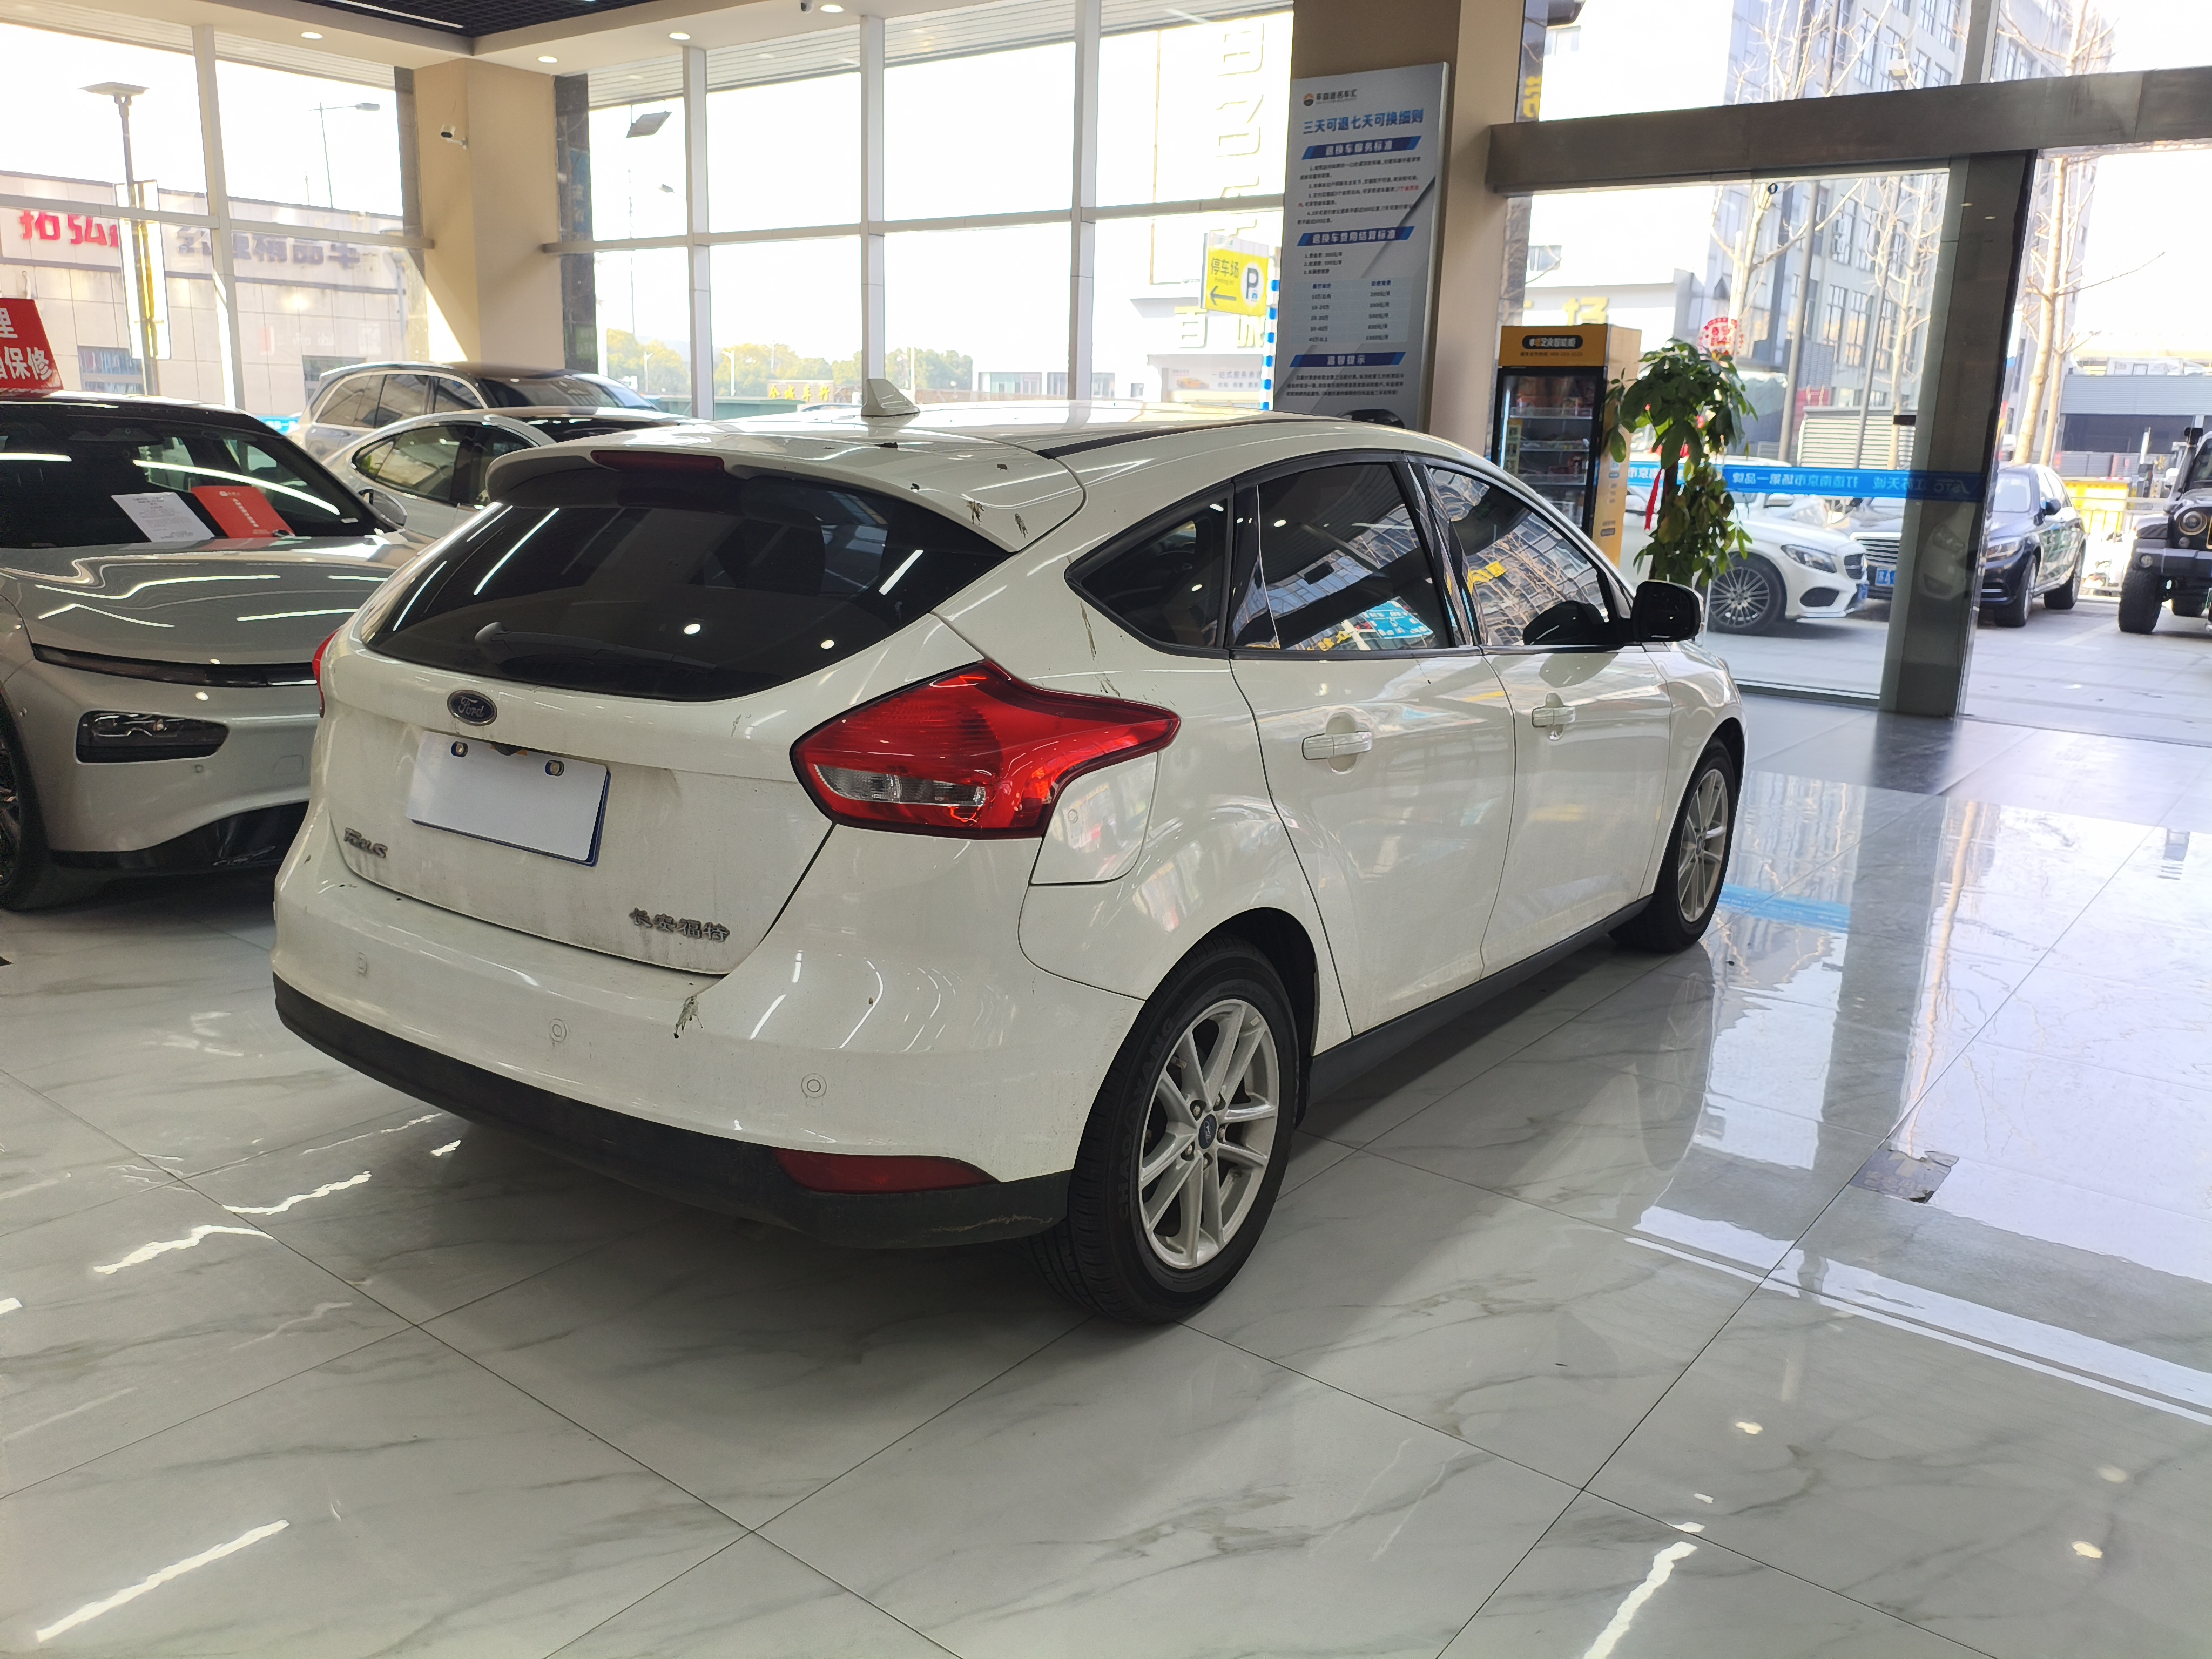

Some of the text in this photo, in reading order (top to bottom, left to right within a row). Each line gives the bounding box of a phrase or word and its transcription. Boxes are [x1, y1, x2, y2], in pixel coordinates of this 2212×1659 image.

[1246, 267, 1259, 299] P
[458, 697, 485, 718] Ford
[630, 908, 730, 943] 长安福特
